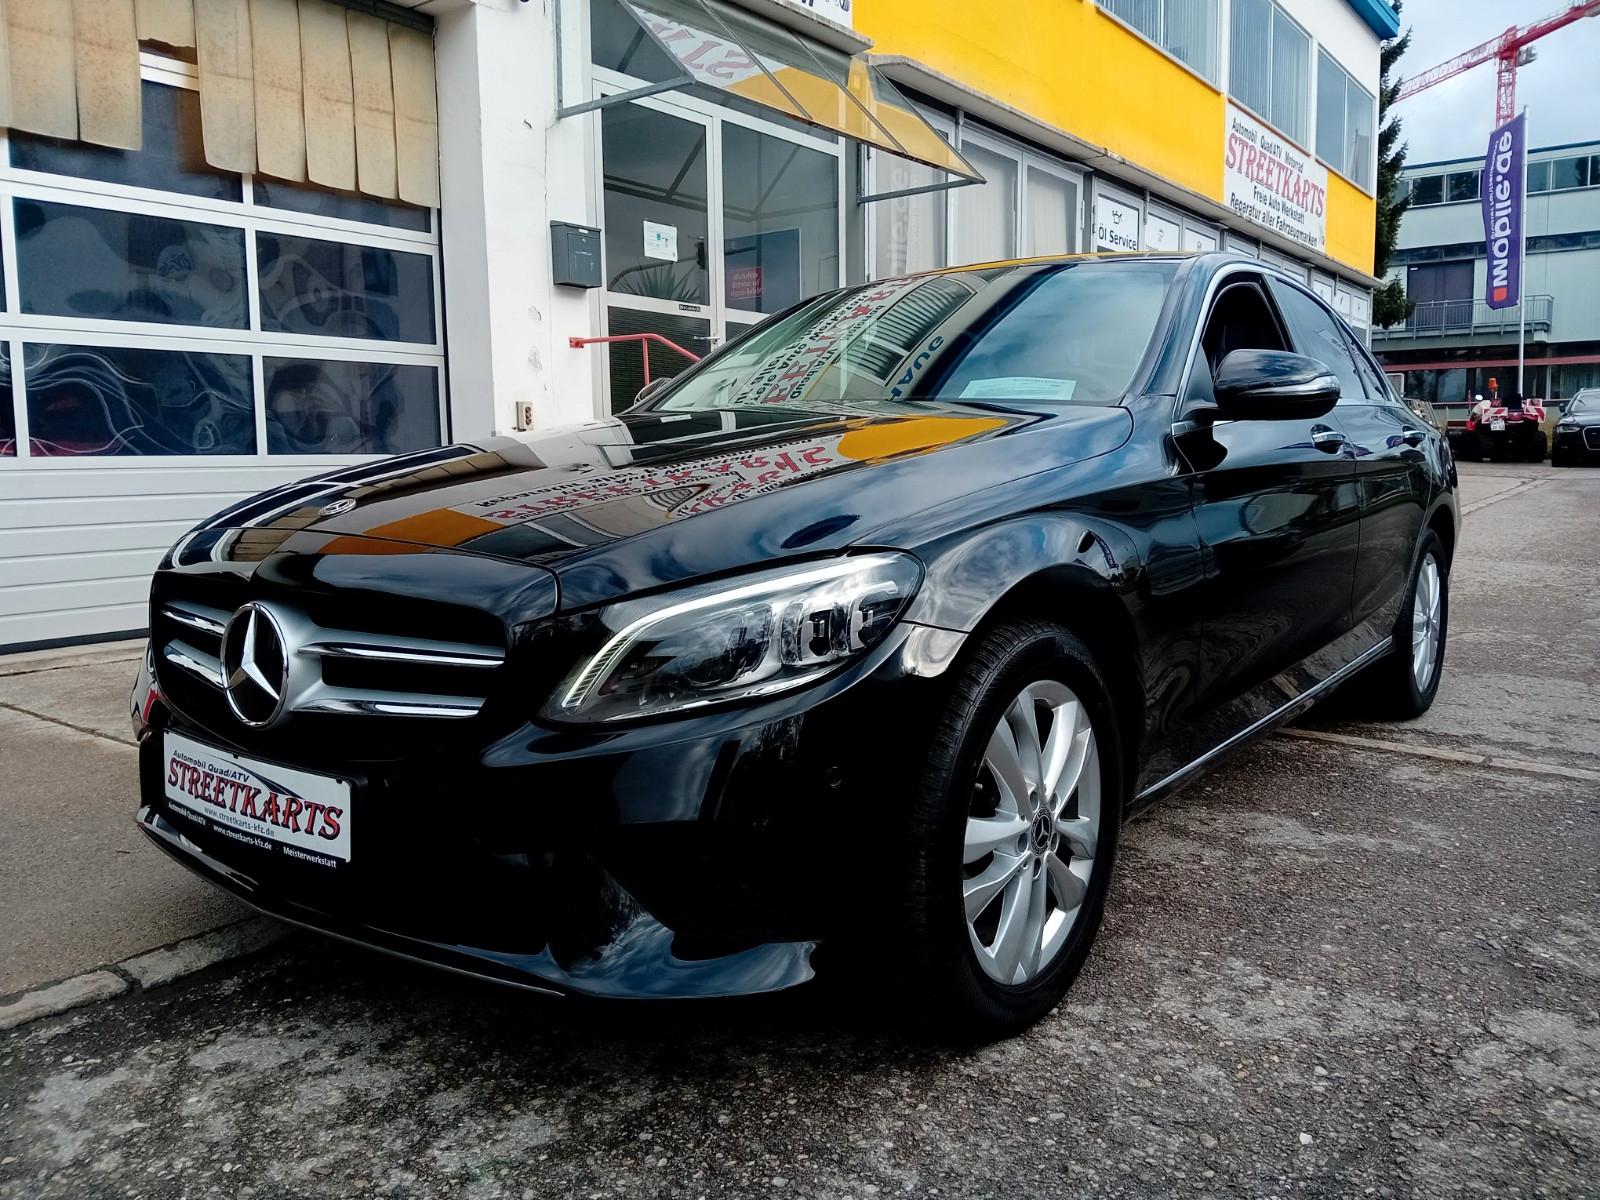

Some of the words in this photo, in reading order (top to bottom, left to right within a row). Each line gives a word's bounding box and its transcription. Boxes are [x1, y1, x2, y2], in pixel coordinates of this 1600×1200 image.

[1231, 117, 1258, 143] Automobil
[1285, 151, 1305, 174] Motorrad
[1225, 132, 1325, 218] STREETKARTS
[1230, 192, 1262, 221] Reparatur
[1261, 209, 1275, 229] aller
[1275, 215, 1318, 248] Fahrzeugmarken
[1253, 185, 1268, 207] Freie
[1268, 193, 1281, 212] Auto
[1281, 201, 1305, 225] Werkstatt
[1098, 223, 1107, 241] Öl
[1109, 229, 1137, 251] Service
[173, 749, 206, 769] Automobil
[208, 763, 250, 782] Quad/ATV
[167, 757, 344, 840] STREETKARTS
[203, 807, 276, 837] www.streetkarts-kfz.de
[213, 825, 272, 850] www.streetkarts-kfz.de
[283, 845, 337, 869] Meisterwerkstatt
